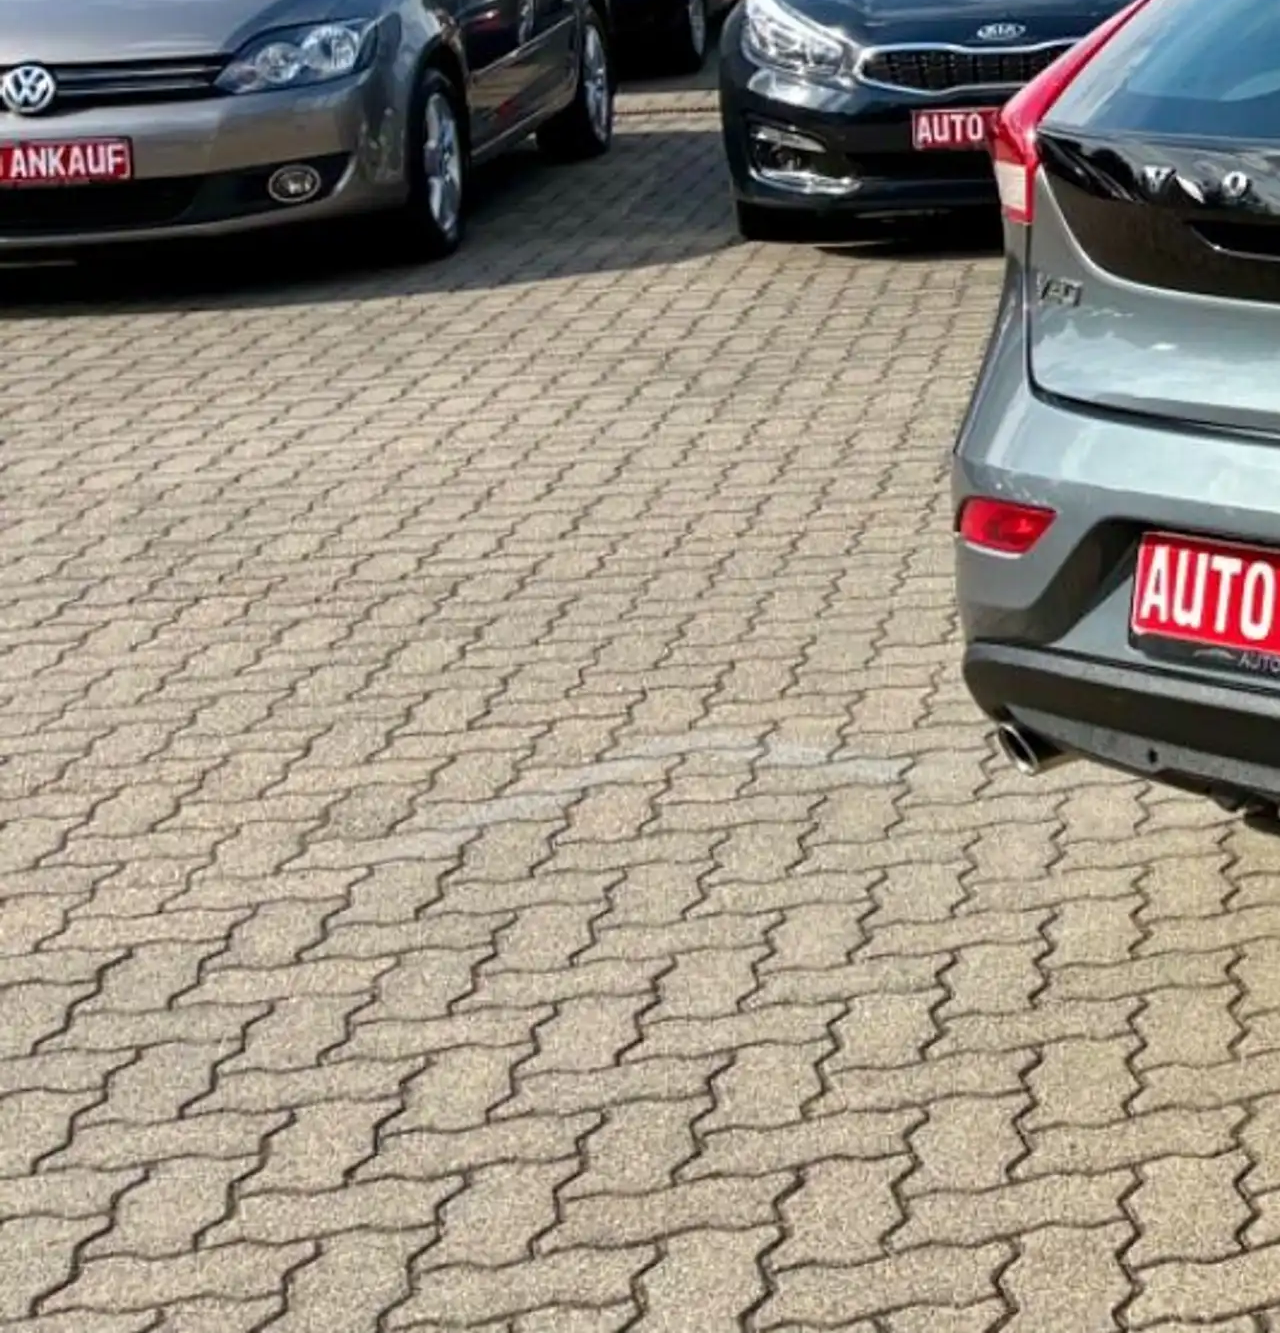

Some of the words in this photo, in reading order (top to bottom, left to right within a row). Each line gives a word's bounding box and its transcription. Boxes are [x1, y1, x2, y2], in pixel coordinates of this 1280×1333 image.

[917, 114, 983, 143] AUTO
[10, 145, 124, 178] ANKAUF
[1140, 546, 1275, 640] AUTO
